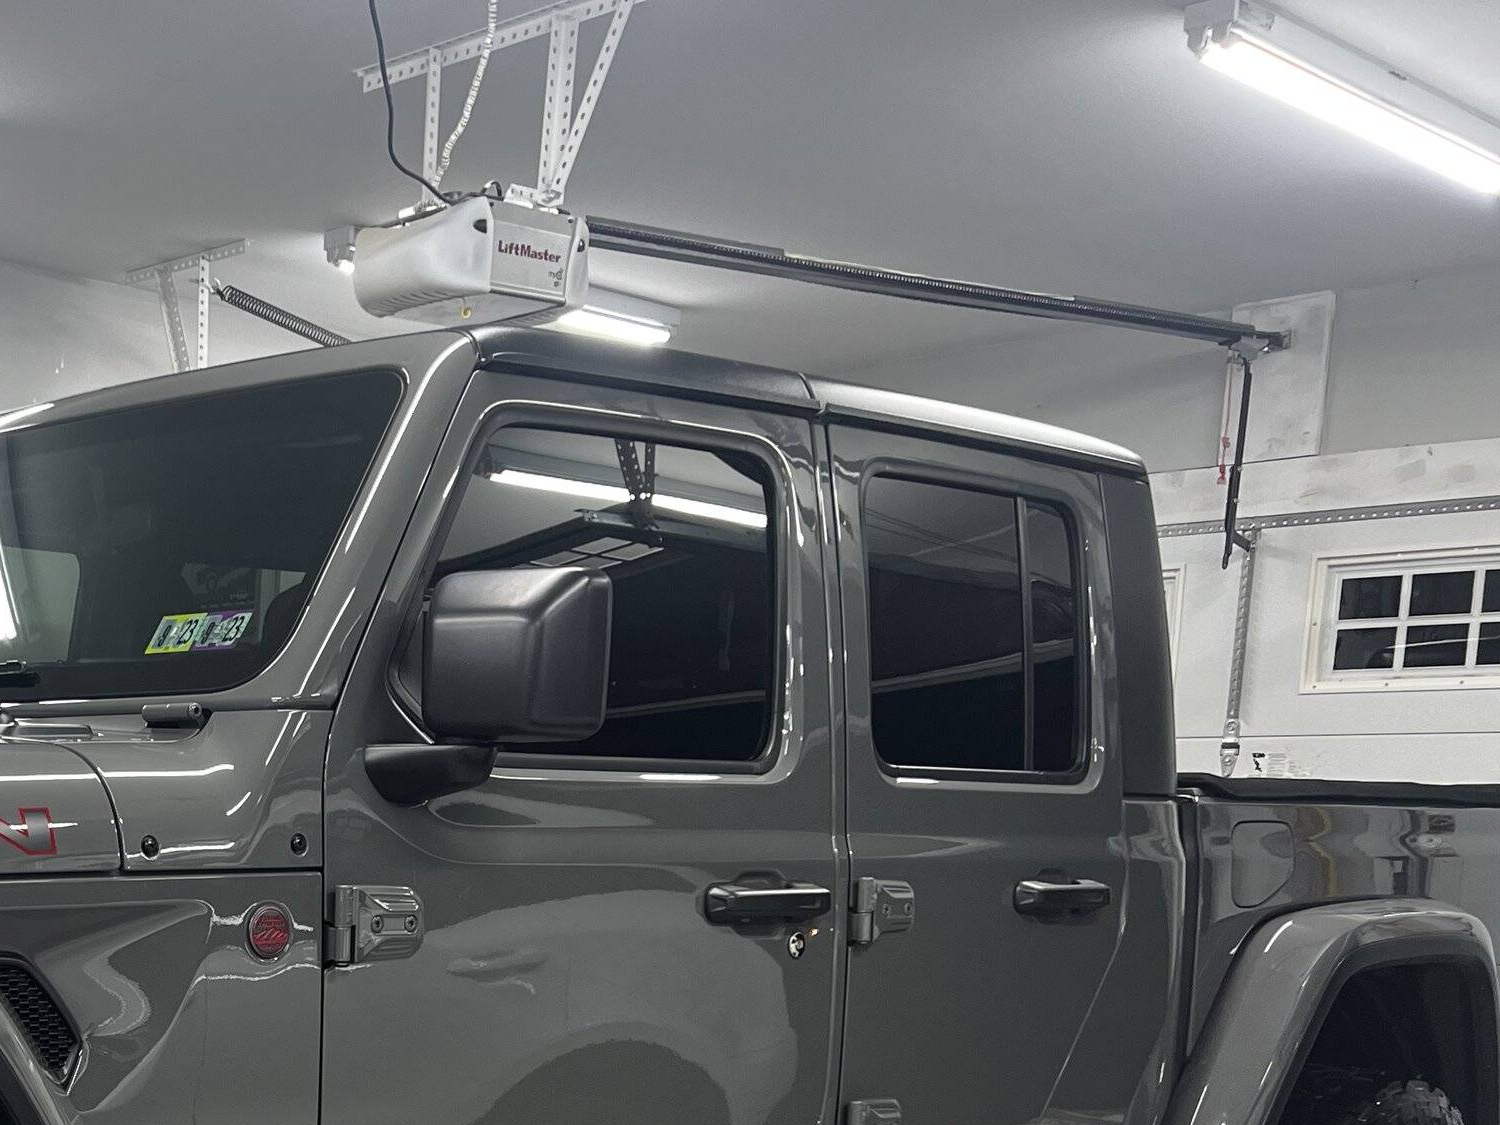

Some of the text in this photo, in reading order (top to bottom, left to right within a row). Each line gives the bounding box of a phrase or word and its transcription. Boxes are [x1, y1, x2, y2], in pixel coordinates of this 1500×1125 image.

[497, 239, 562, 264] LiftMaster
[176, 619, 200, 645] 23
[221, 615, 246, 642] 23
